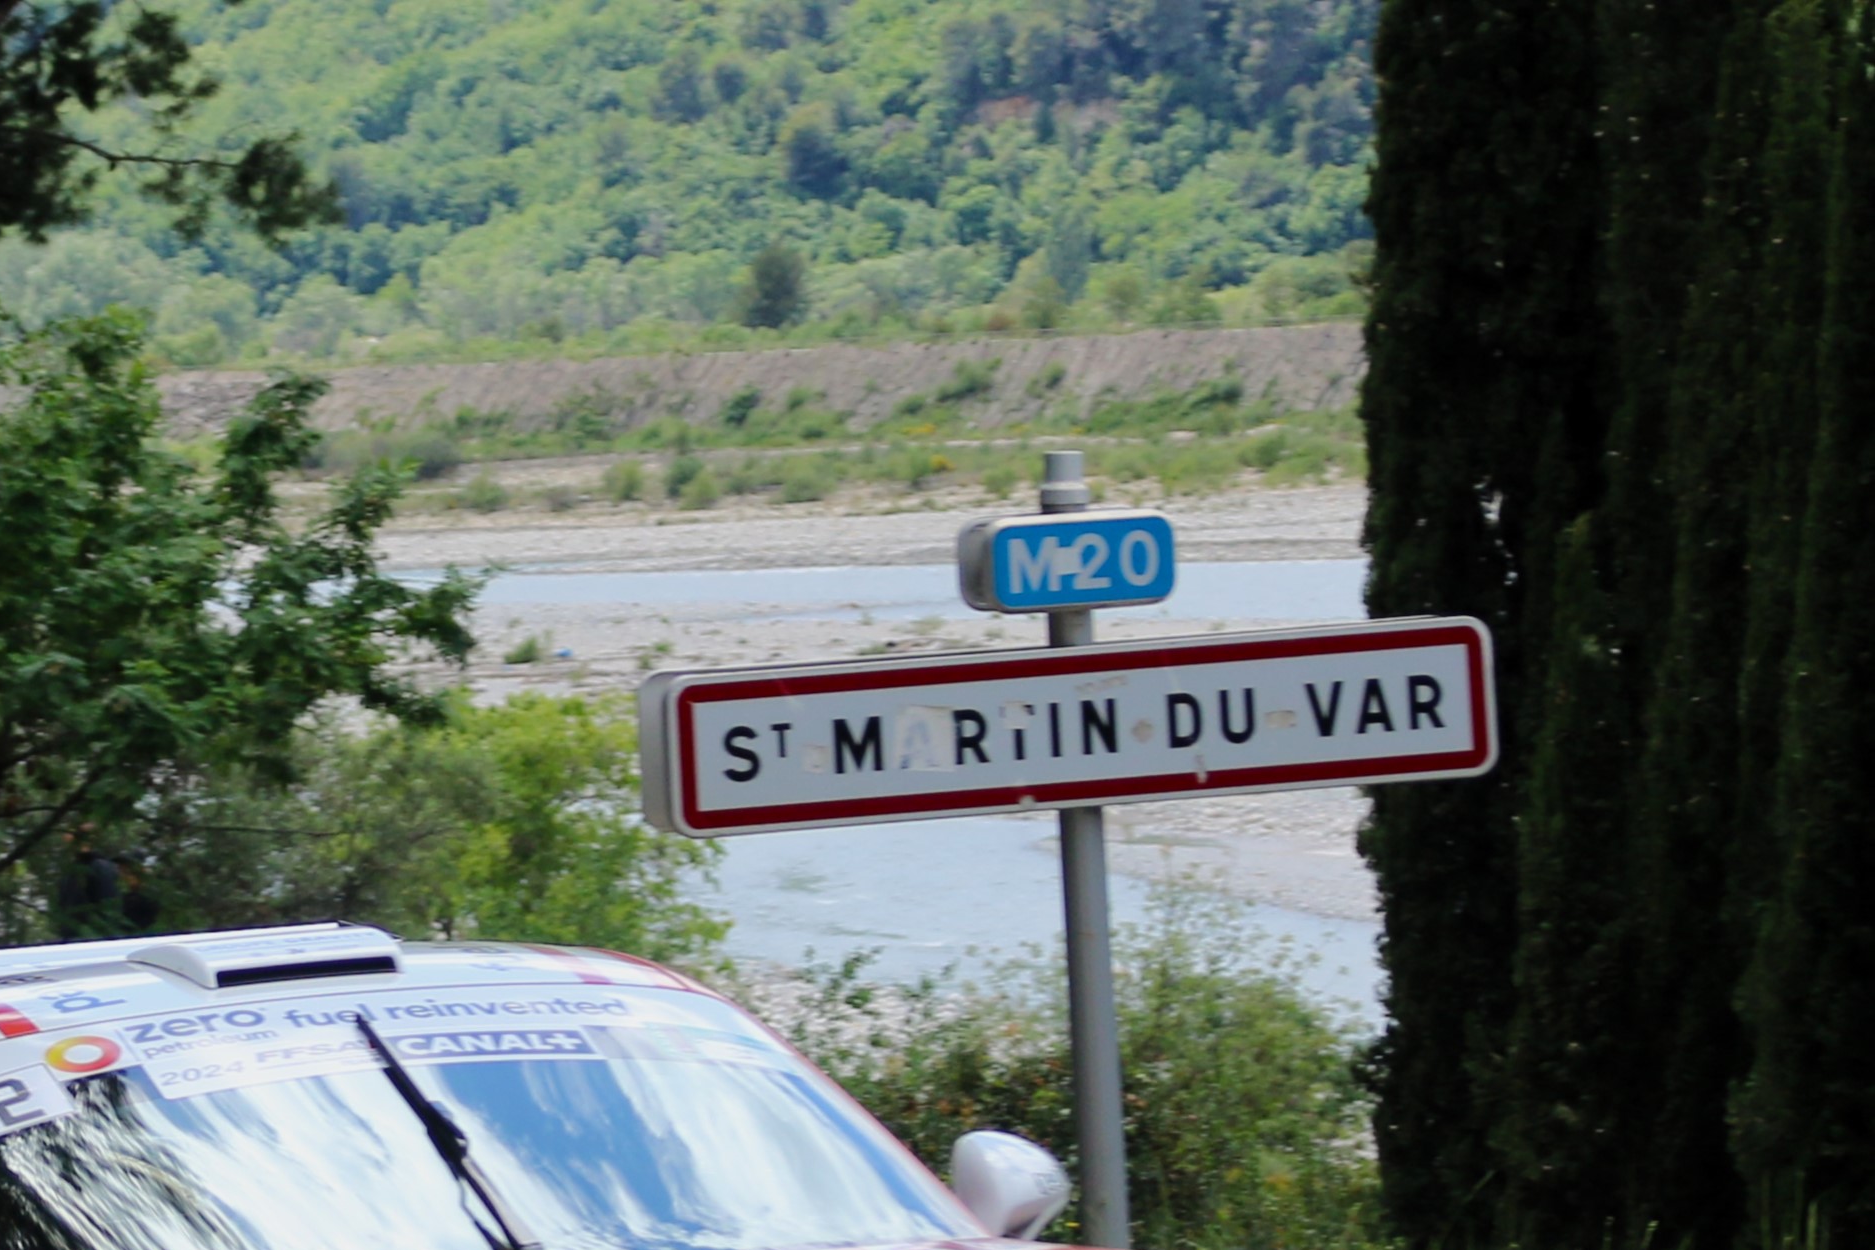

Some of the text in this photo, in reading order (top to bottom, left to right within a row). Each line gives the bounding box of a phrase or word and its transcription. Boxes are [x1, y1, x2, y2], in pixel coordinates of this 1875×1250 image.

[833, 698, 1119, 774] MRTIN
[1166, 687, 1256, 748] DU
[1304, 674, 1445, 737] VAR
[124, 998, 631, 1044] zero fuel reinvented
[143, 1028, 279, 1060] petroleum
[397, 1032, 584, 1055] CANAL+
[159, 1060, 246, 1086] 2024
